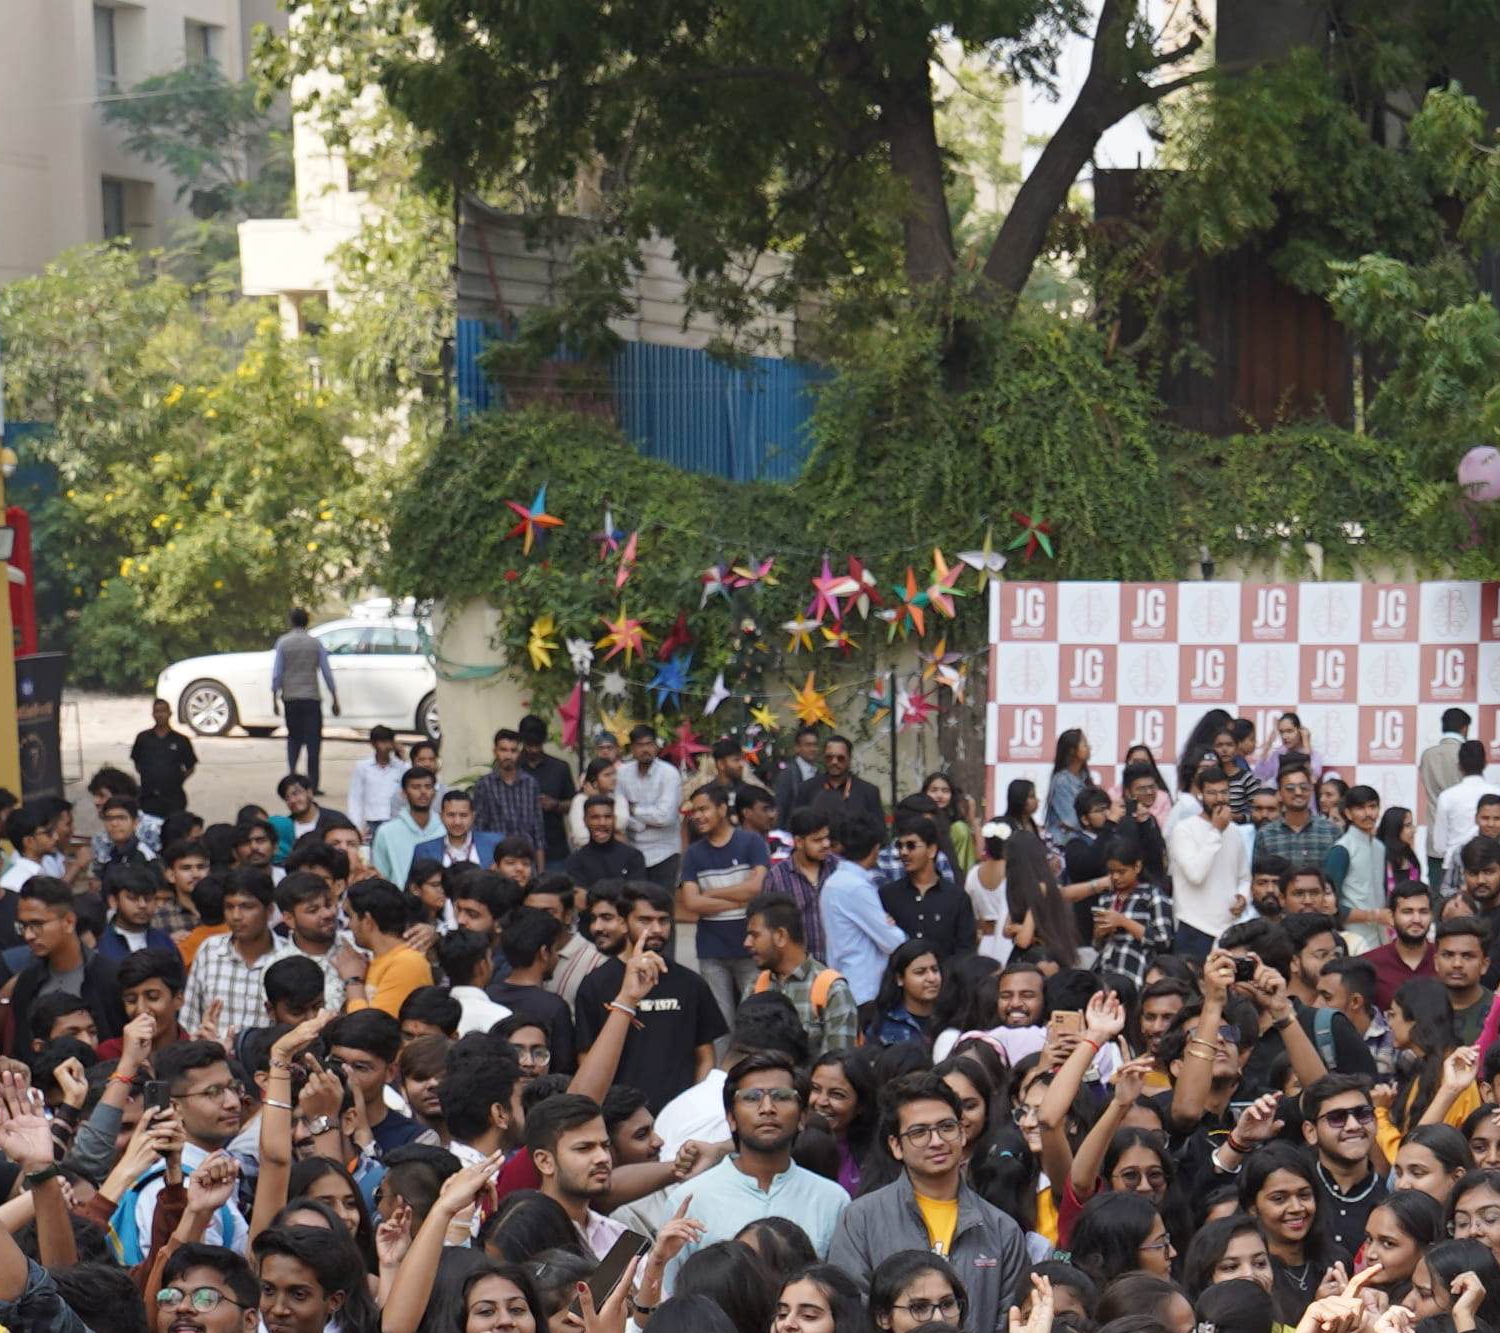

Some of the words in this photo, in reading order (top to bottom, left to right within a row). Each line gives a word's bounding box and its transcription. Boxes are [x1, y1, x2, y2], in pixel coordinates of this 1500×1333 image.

[1010, 587, 1046, 627] JG
[1131, 588, 1167, 628] JG
[1252, 588, 1287, 628] JG
[1372, 589, 1407, 628] JG
[1069, 648, 1104, 688] JG
[1190, 648, 1225, 688] JG
[1311, 648, 1346, 688] JG
[1430, 648, 1465, 688] JG
[1009, 708, 1044, 748] JG
[1129, 709, 1164, 749] JG
[1369, 710, 1404, 750] JG
